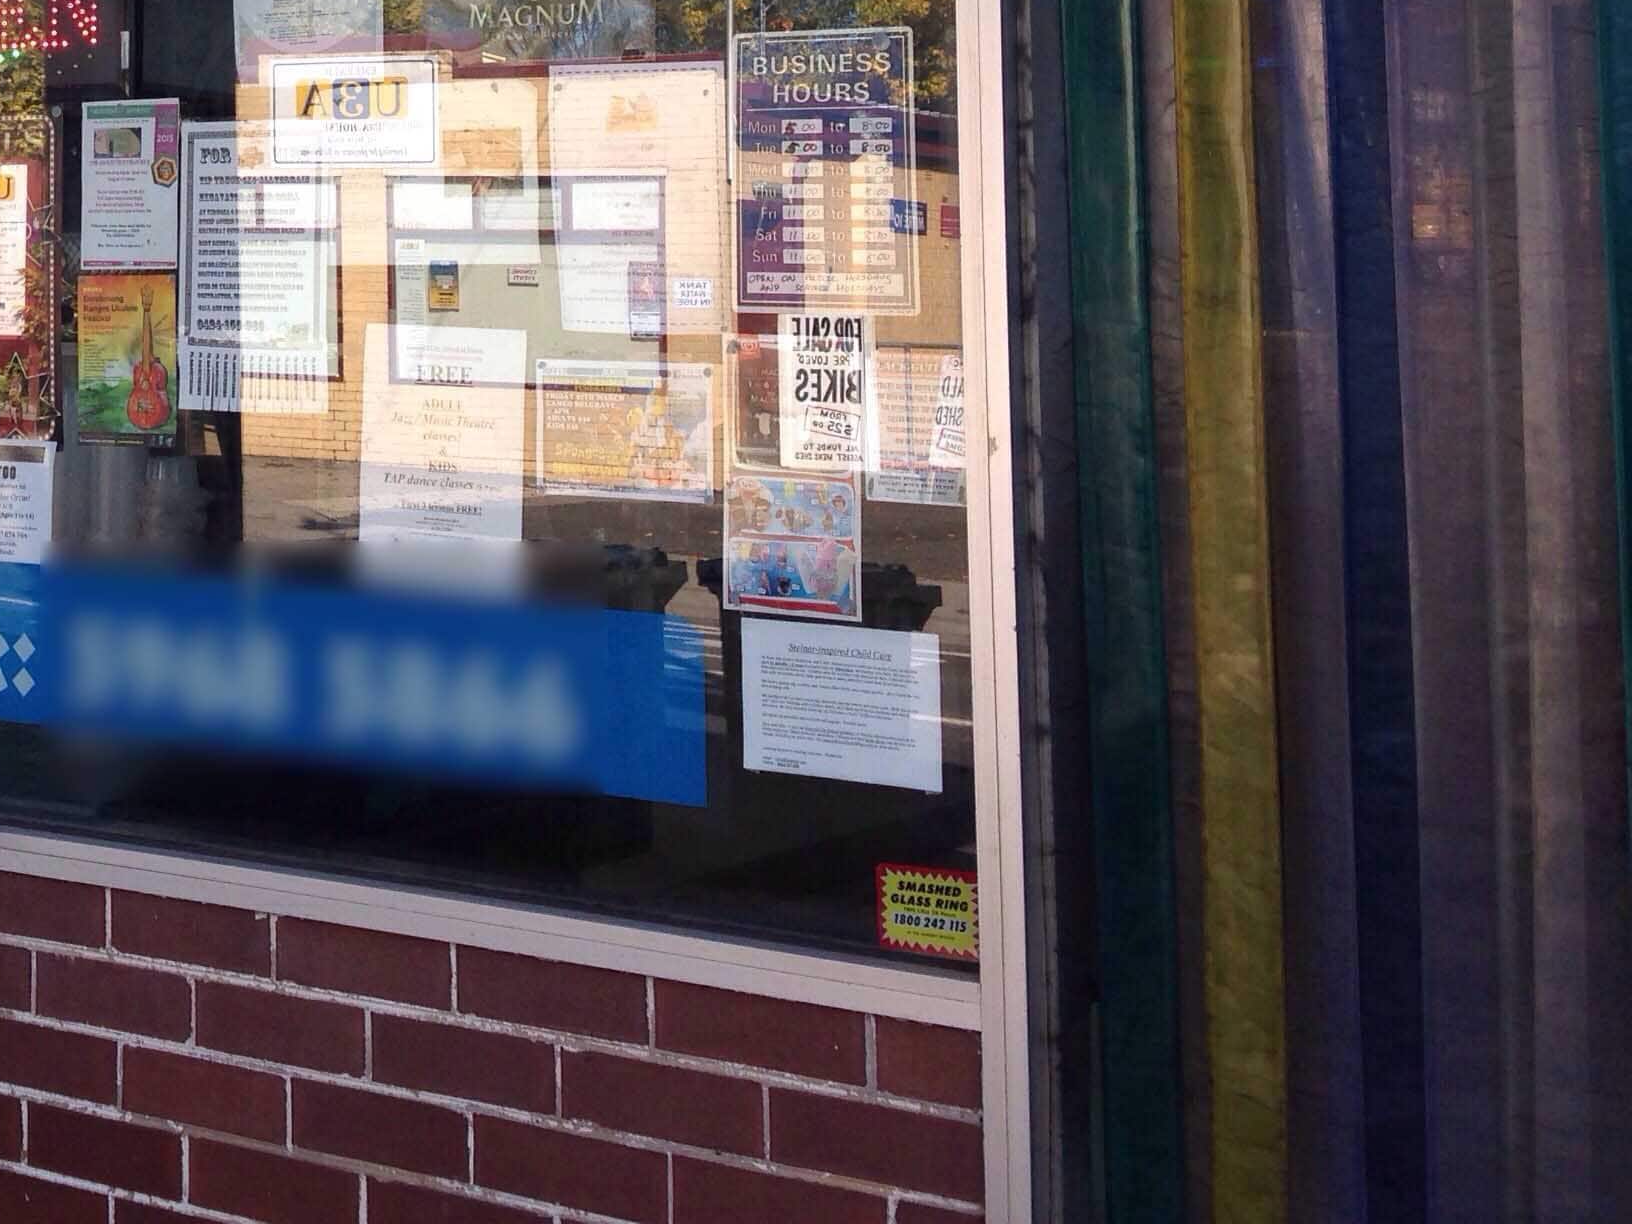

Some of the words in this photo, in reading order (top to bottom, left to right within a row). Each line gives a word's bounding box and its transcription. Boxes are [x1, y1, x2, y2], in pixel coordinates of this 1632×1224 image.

[753, 52, 892, 76] BUSINESS
[772, 83, 871, 104] HOURS
[748, 121, 776, 134] Mon
[199, 147, 231, 165] FOR
[755, 143, 776, 154] Tue
[761, 207, 777, 219] Fri
[755, 229, 777, 241] Sat
[753, 251, 777, 262] Sun
[416, 364, 473, 384] FREE
[384, 473, 405, 485] TAP
[407, 474, 437, 488] dance
[440, 476, 473, 490] classes
[851, 648, 872, 659] Child
[898, 880, 962, 897] SMASHED
[890, 894, 931, 908] GLASS
[935, 898, 968, 912] RING
[894, 913, 921, 926] 1800
[923, 917, 946, 930] 242
[949, 920, 967, 933] 115
